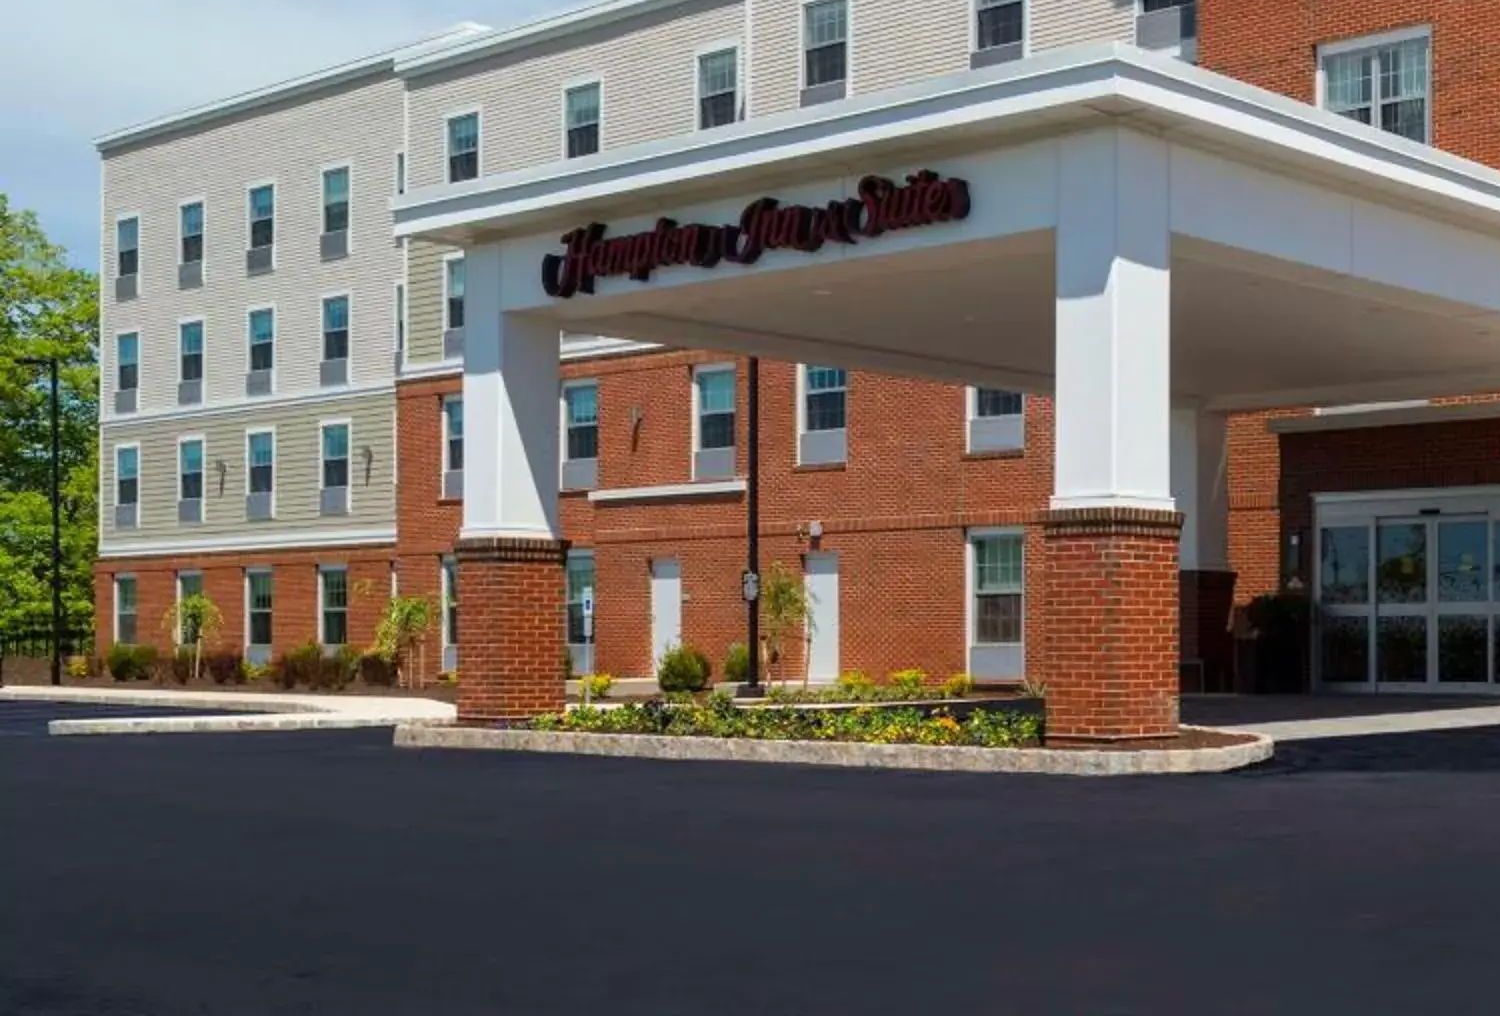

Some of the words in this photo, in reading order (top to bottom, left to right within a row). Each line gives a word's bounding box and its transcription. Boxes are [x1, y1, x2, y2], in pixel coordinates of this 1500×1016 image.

[542, 217, 720, 298] Hampton
[721, 197, 826, 264] Inn
[846, 169, 970, 237] Suites
